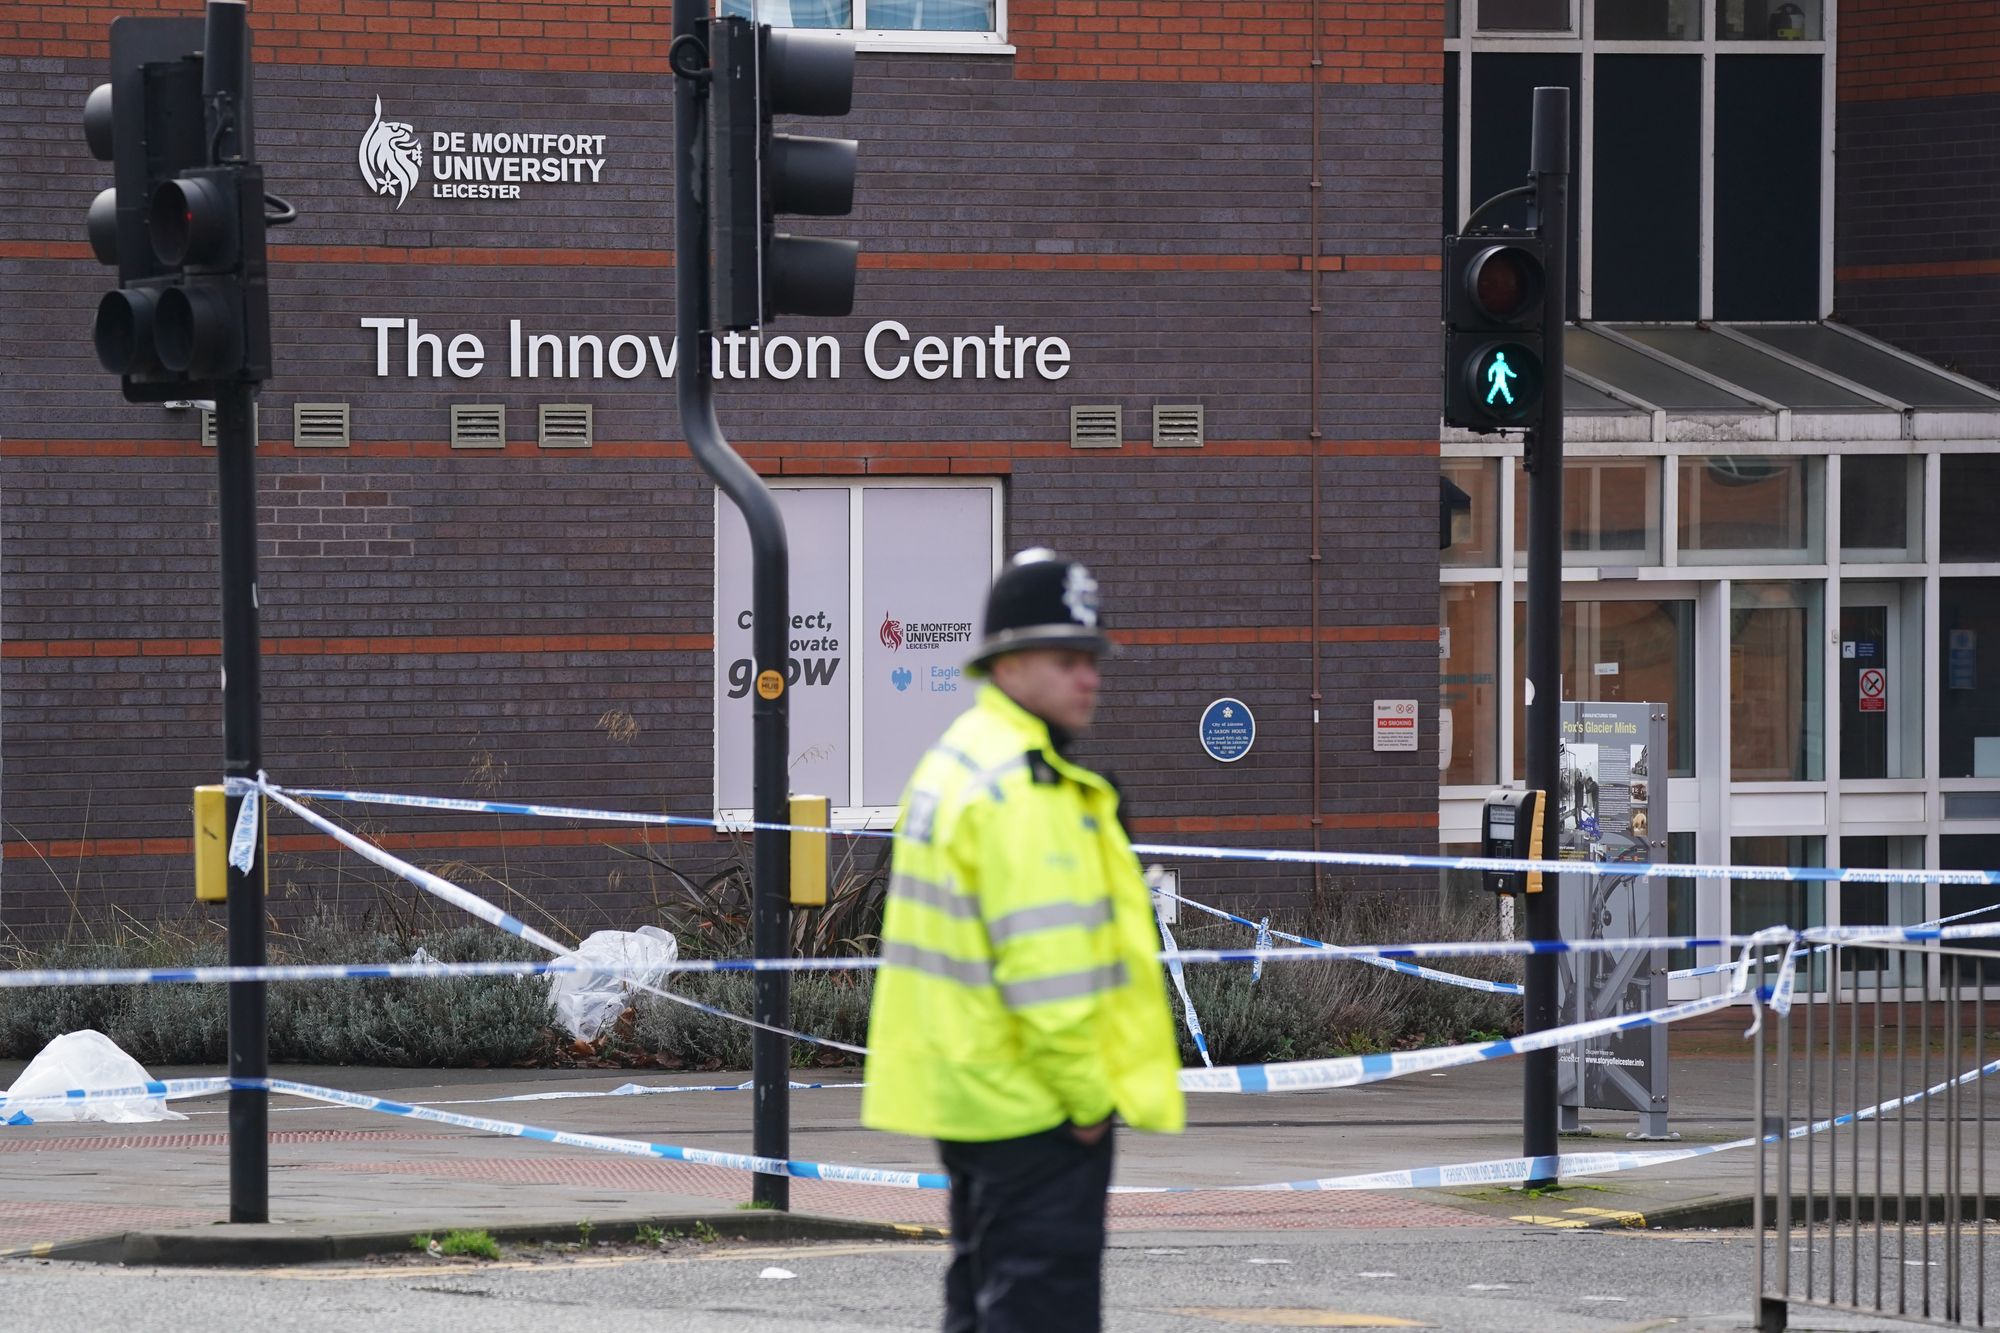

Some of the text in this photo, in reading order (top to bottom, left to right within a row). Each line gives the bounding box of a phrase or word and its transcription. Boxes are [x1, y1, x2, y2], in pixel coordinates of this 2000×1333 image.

[433, 132, 607, 155] DE MONTFORT
[433, 157, 607, 184] UNIVERSITY
[433, 184, 521, 199] LEICESTER
[360, 317, 485, 379] The
[864, 320, 1071, 381] Centre
[906, 623, 972, 632] DE MONTFORT
[906, 632, 972, 642] UNIVERSITY
[931, 666, 960, 680] Eagle
[931, 681, 957, 692] Labs
[1562, 721, 1637, 734] Fox's Glacier Mints
[1585, 1056, 1645, 1067] www.storyofleicester.info
